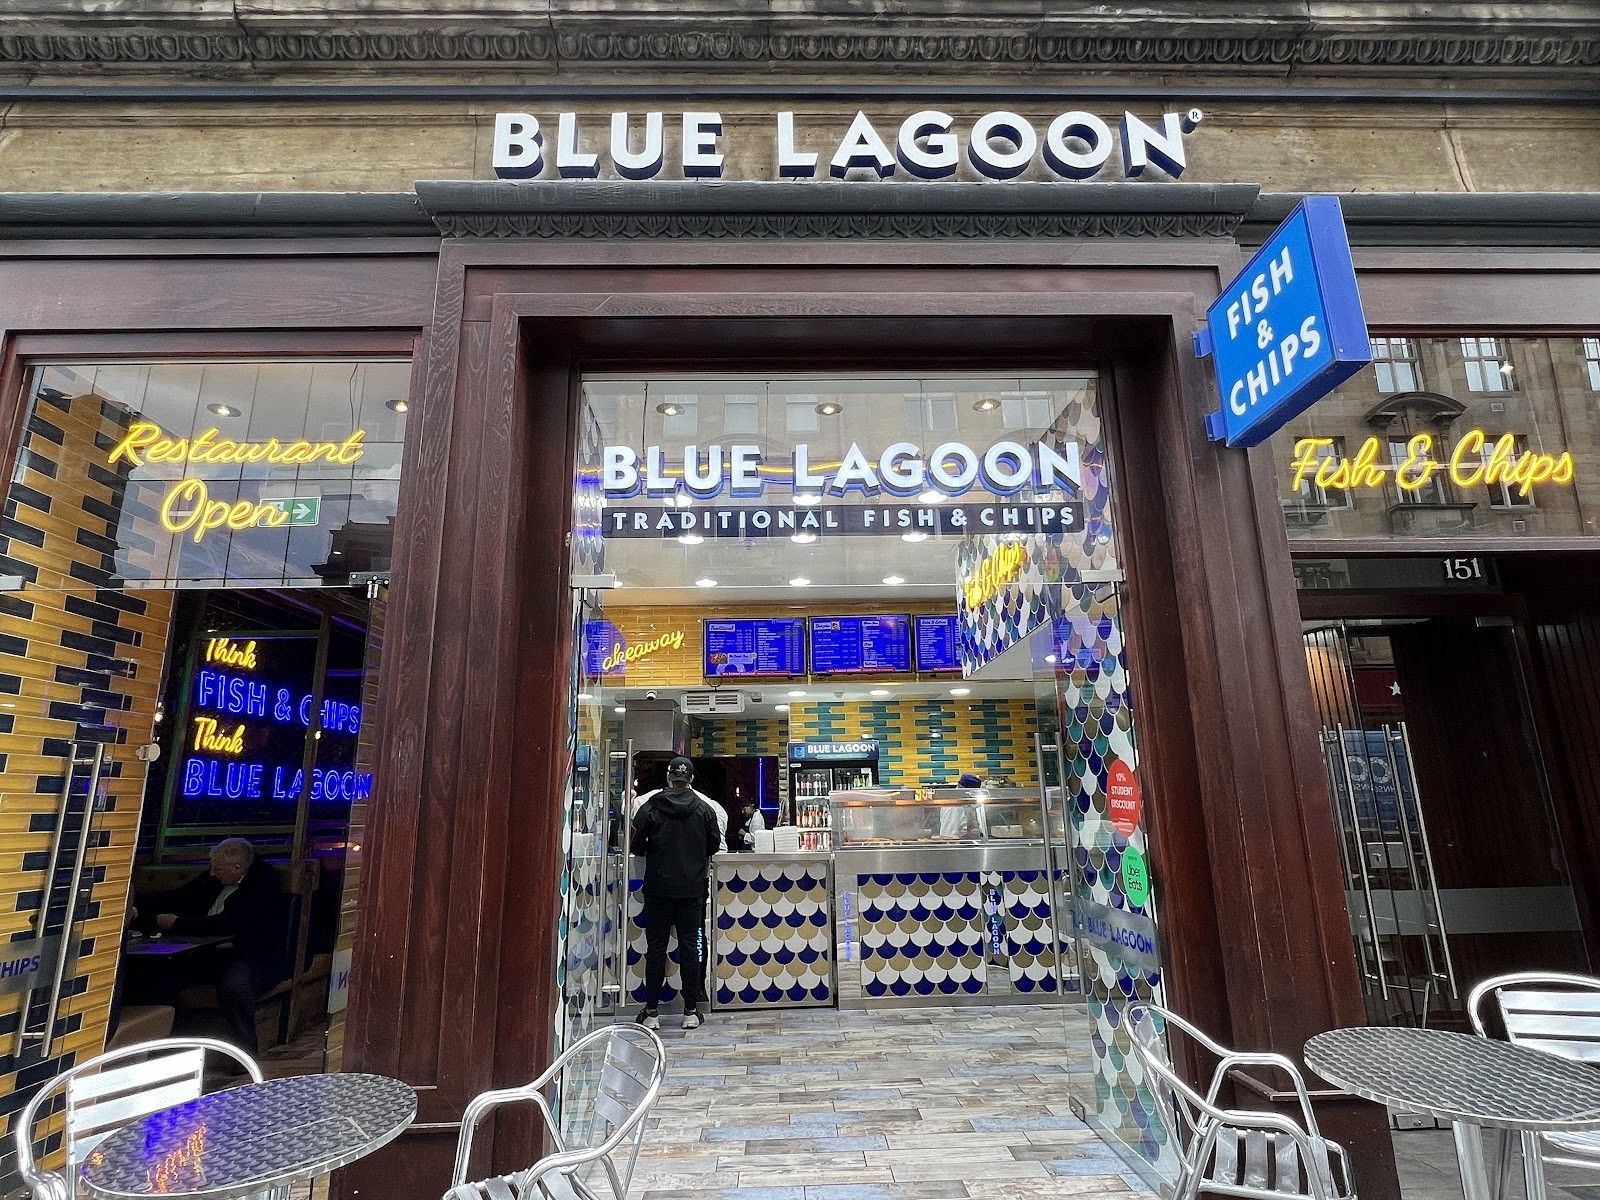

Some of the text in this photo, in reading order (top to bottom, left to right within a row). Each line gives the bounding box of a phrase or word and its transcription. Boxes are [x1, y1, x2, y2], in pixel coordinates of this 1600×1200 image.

[491, 111, 724, 178] BLUE
[777, 109, 1187, 179] LAGOON
[1226, 246, 1294, 340] FISH
[1256, 318, 1274, 350] &
[1229, 315, 1321, 416] CHIPS
[108, 422, 366, 466] Restaurant
[1288, 428, 1574, 497] Fish & Chips
[602, 441, 1082, 497] BLUE LAGOON
[160, 478, 290, 544] Open
[612, 506, 1074, 531] TRADITIONAL FISH & CHIPS
[1442, 558, 1483, 580] 151
[205, 637, 257, 669] Think
[602, 630, 685, 671] akeaway
[198, 670, 267, 717] FISH
[274, 688, 292, 720] &
[194, 715, 246, 754] Think
[807, 743, 875, 754] BLUE LAGOON
[183, 758, 372, 801] BLUE LAGOON
[1110, 786, 1134, 797] STUDENT
[1110, 799, 1137, 811] DISCOUNT
[1126, 865, 1141, 877] Uber
[1127, 876, 1144, 892] Eats
[991, 916, 1000, 955] LAGOON
[1087, 917, 1108, 939] BLUE
[1109, 924, 1154, 956] LAGOON
[0, 955, 41, 979] HIPS
